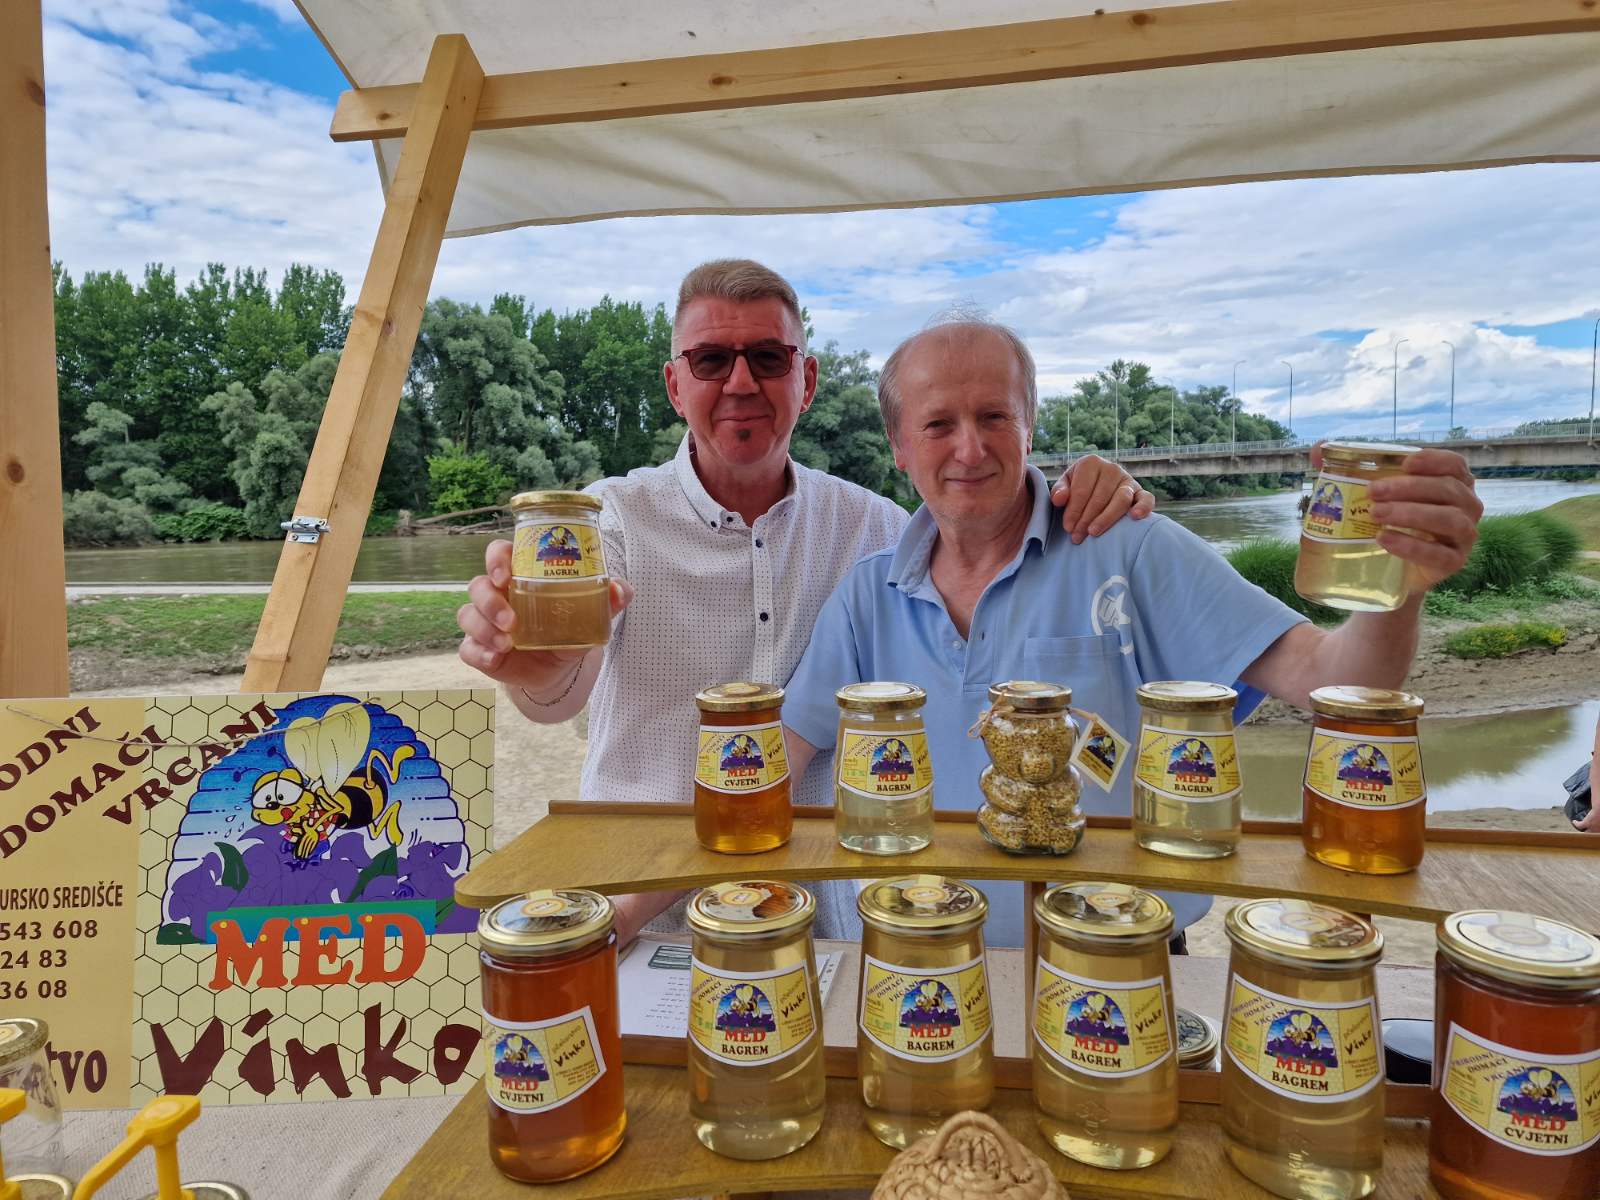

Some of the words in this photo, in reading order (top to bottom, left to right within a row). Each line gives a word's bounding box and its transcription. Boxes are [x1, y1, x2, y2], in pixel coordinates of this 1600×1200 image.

[544, 555, 576, 567] MED
[544, 568, 579, 577] BAGREM
[102, 701, 280, 825] VRCANI
[727, 767, 758, 777] MED
[878, 771, 908, 782] MED
[1175, 773, 1209, 784] MED
[724, 778, 760, 787] CVJETNI
[876, 784, 912, 792] BAGREM
[1174, 784, 1213, 793] BAGREM
[1345, 779, 1385, 792] MED
[0, 725, 167, 859] DOMAČI
[1341, 790, 1387, 803] CVJETNI
[52, 880, 123, 909] SREDIŠĆE
[0, 921, 42, 941] 543
[53, 920, 98, 939] 608
[0, 950, 29, 970] 24
[39, 949, 67, 968] 83
[208, 913, 427, 990] MED
[0, 981, 28, 1000] 36
[38, 980, 67, 998] 08
[724, 1027, 767, 1043] MED
[910, 1023, 953, 1038] MED
[151, 1001, 482, 1099] Vinko
[721, 1044, 769, 1055] BAGREM
[906, 1040, 955, 1051] BAGREM
[1074, 1034, 1119, 1055] MED
[554, 1039, 586, 1067] Vinko
[1071, 1049, 1121, 1068] BAGREM
[1275, 1054, 1327, 1077] MED
[501, 1077, 539, 1092] MED
[1271, 1070, 1329, 1092] BAGREM
[499, 1090, 545, 1104] CVJETNI
[1510, 1109, 1567, 1132] MED
[1504, 1127, 1569, 1145] CVJETNI
